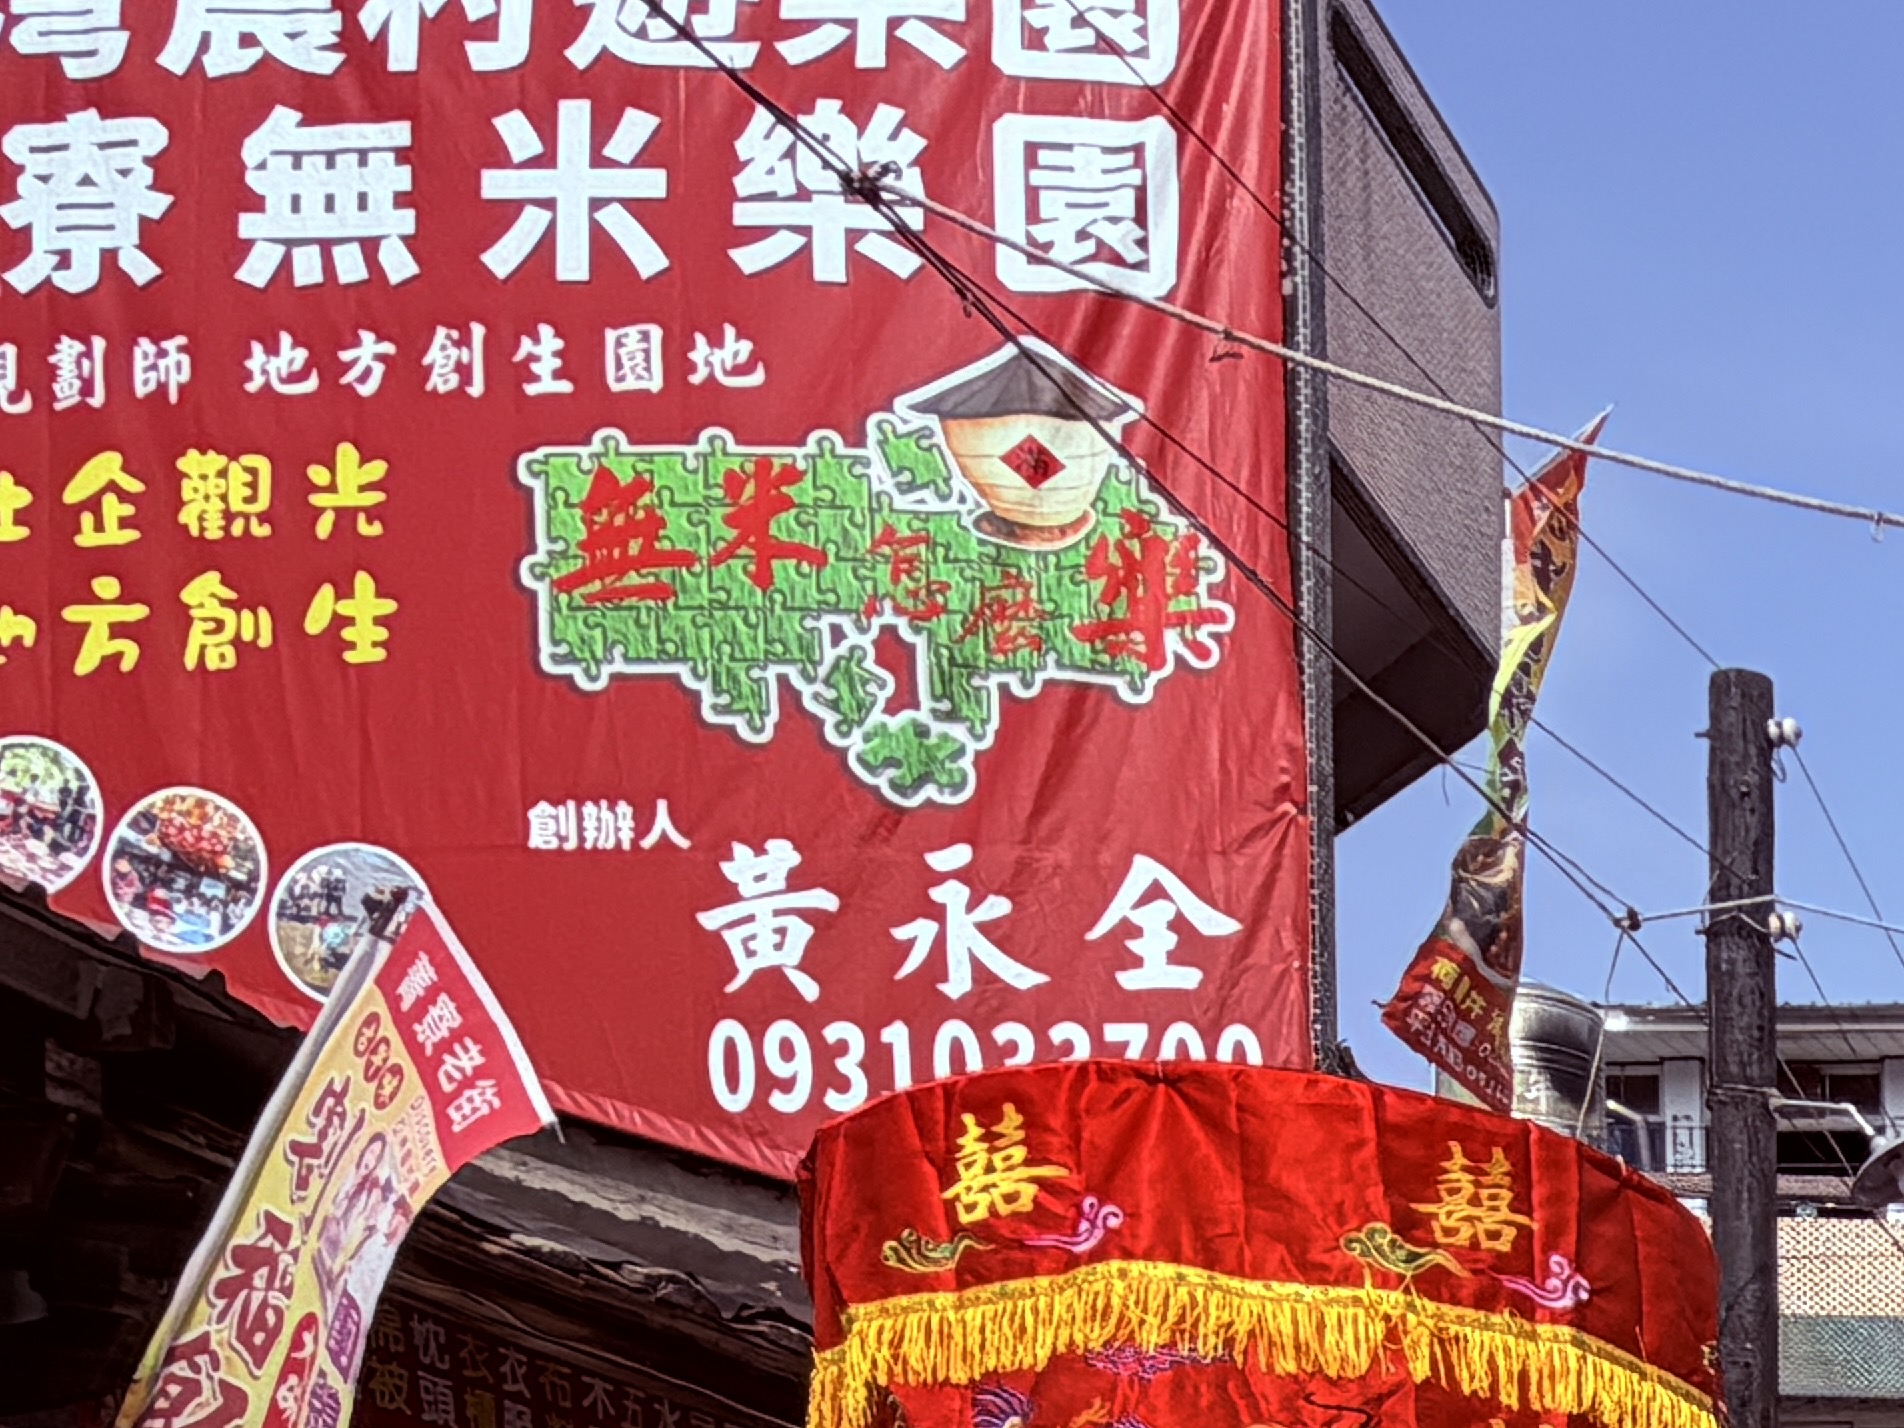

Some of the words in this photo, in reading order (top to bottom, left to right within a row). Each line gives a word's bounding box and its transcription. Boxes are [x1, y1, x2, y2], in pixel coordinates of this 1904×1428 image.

[0, 98, 1178, 298] 寮無米樂園
[243, 321, 767, 398] 地方創生園地
[527, 799, 691, 850] 創辦人
[696, 838, 1244, 1003] 黃永全
